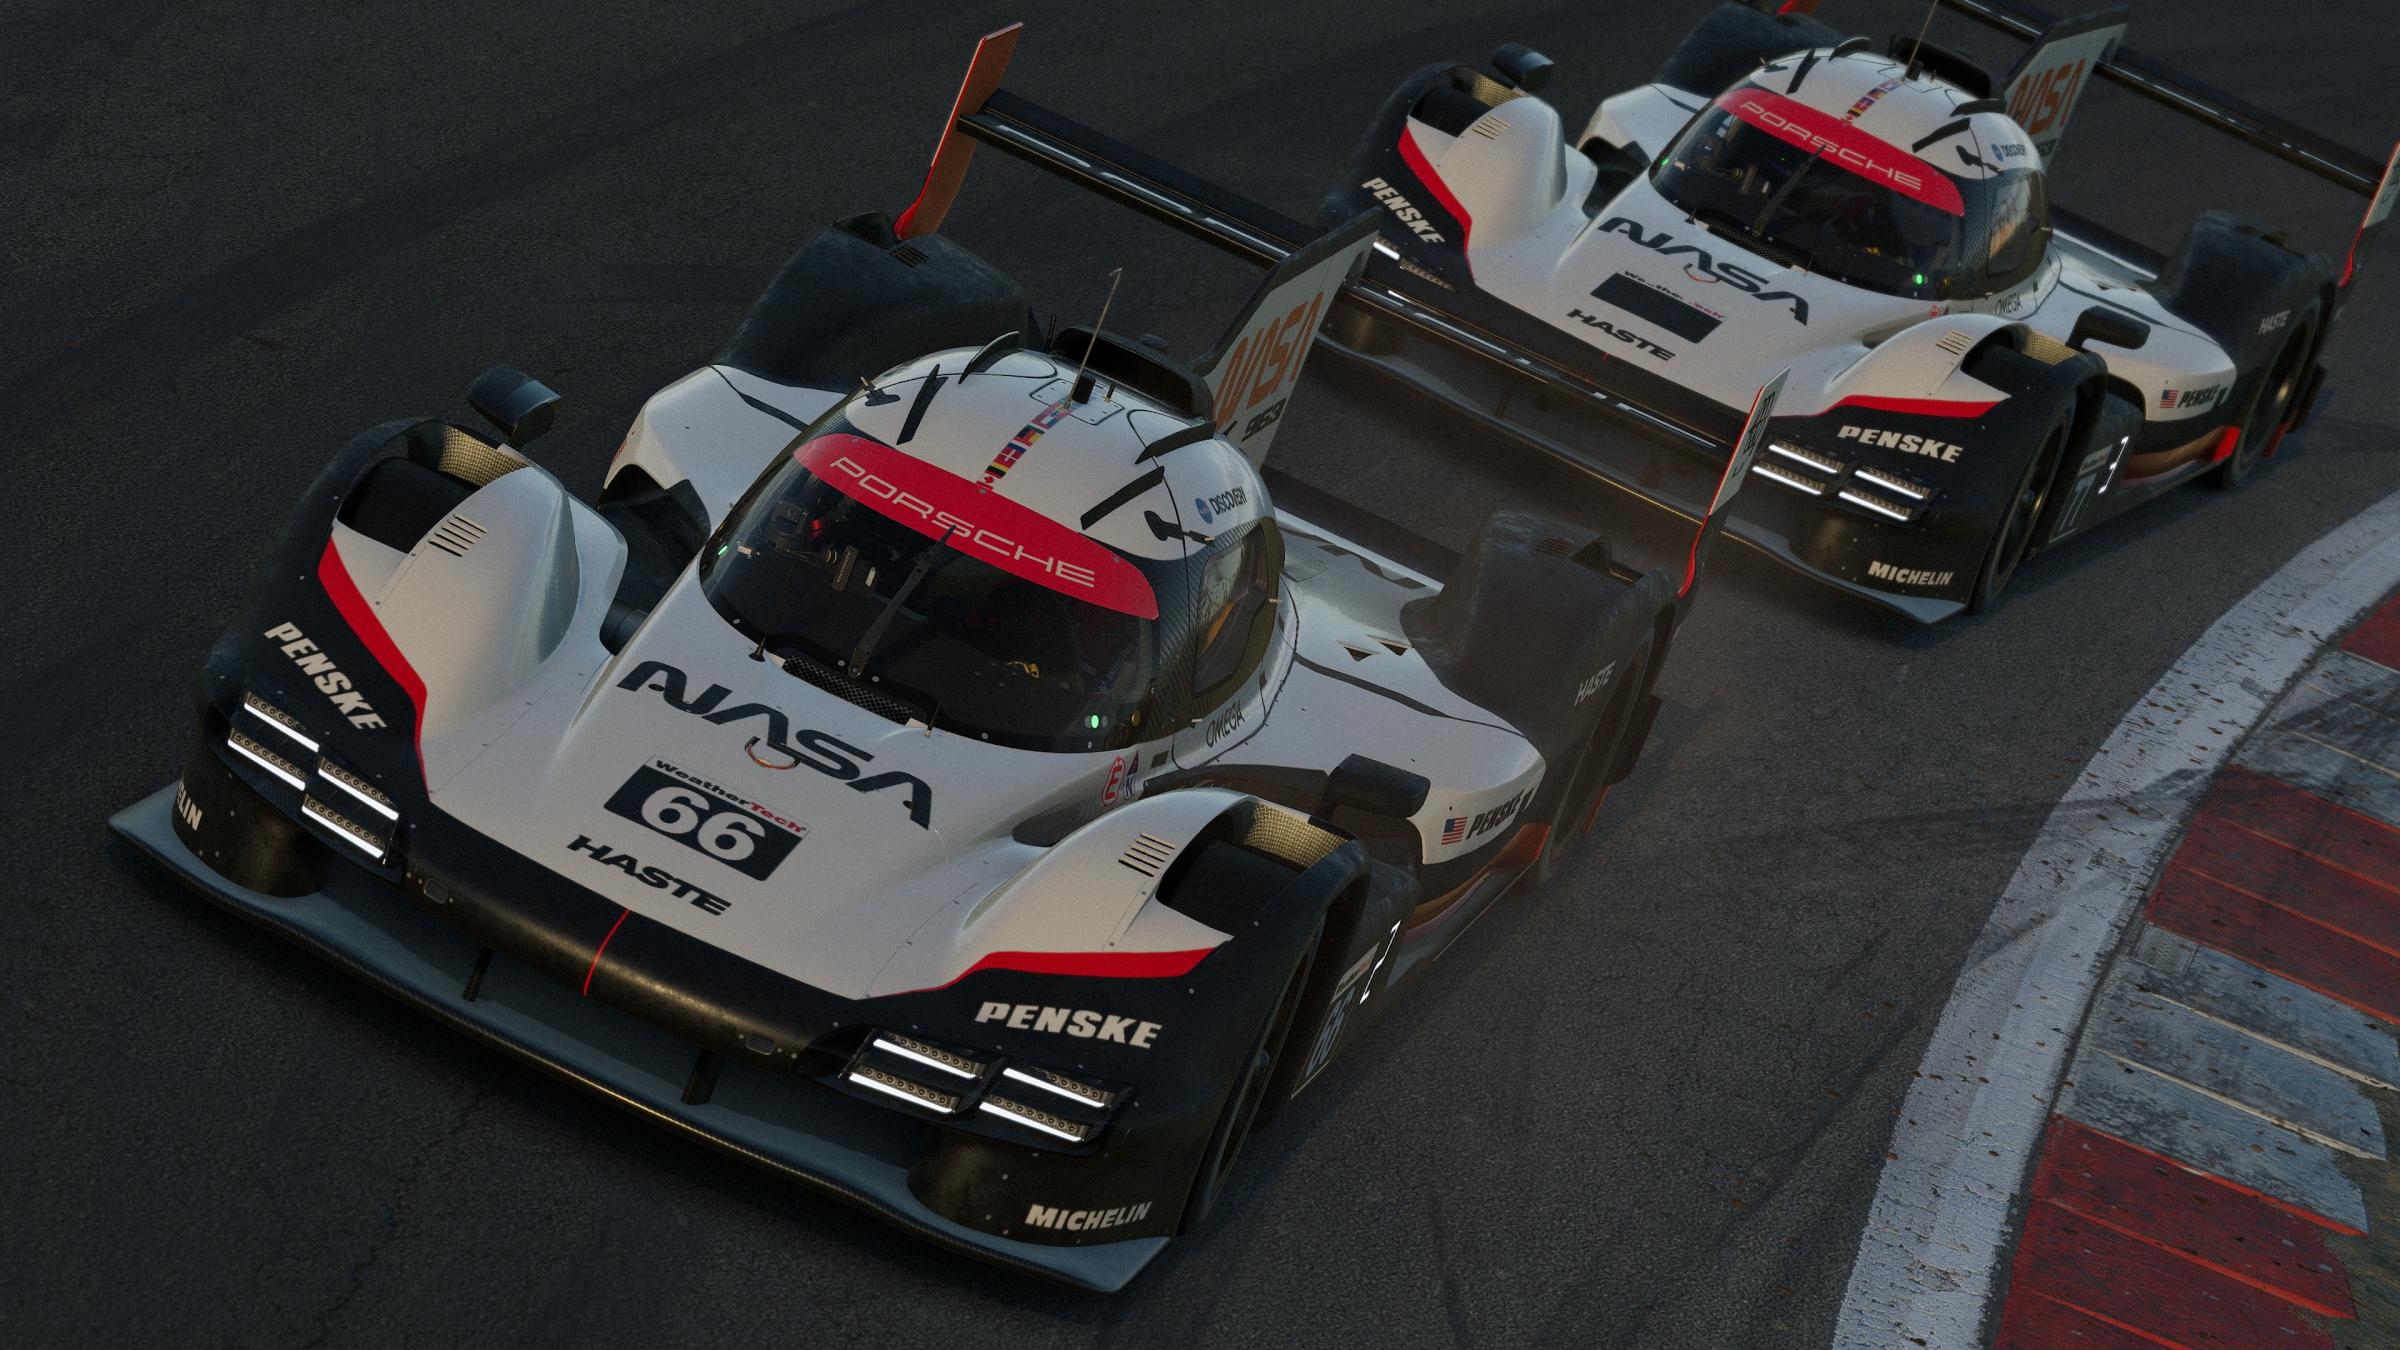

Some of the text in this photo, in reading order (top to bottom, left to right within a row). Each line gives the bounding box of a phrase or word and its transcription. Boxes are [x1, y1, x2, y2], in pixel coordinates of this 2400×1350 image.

[1739, 101, 1922, 191] PORSCHE
[1360, 177, 1446, 243] PENSKE
[1597, 217, 1809, 326] NASA
[1566, 308, 1676, 361] HASTE
[2257, 310, 2290, 335] HASTE
[2177, 384, 2220, 408] PENSKE
[1837, 425, 1963, 464] PENSKE
[829, 456, 1096, 588] PORSCHE
[1208, 486, 1248, 515] DISCOVERY
[1868, 561, 1954, 588] MICHELIN
[263, 621, 387, 731] PENSKE
[1574, 660, 1617, 706] HASTE
[616, 660, 932, 830] NASA
[1206, 699, 1246, 748] OMEGA
[656, 760, 806, 833] WeatherTech
[1466, 788, 1525, 840] PENSKE
[640, 786, 767, 861] 66
[567, 835, 731, 916] HASTE
[975, 1001, 1162, 1049] PENSKE
[1023, 1201, 1152, 1232] MICHELIN
